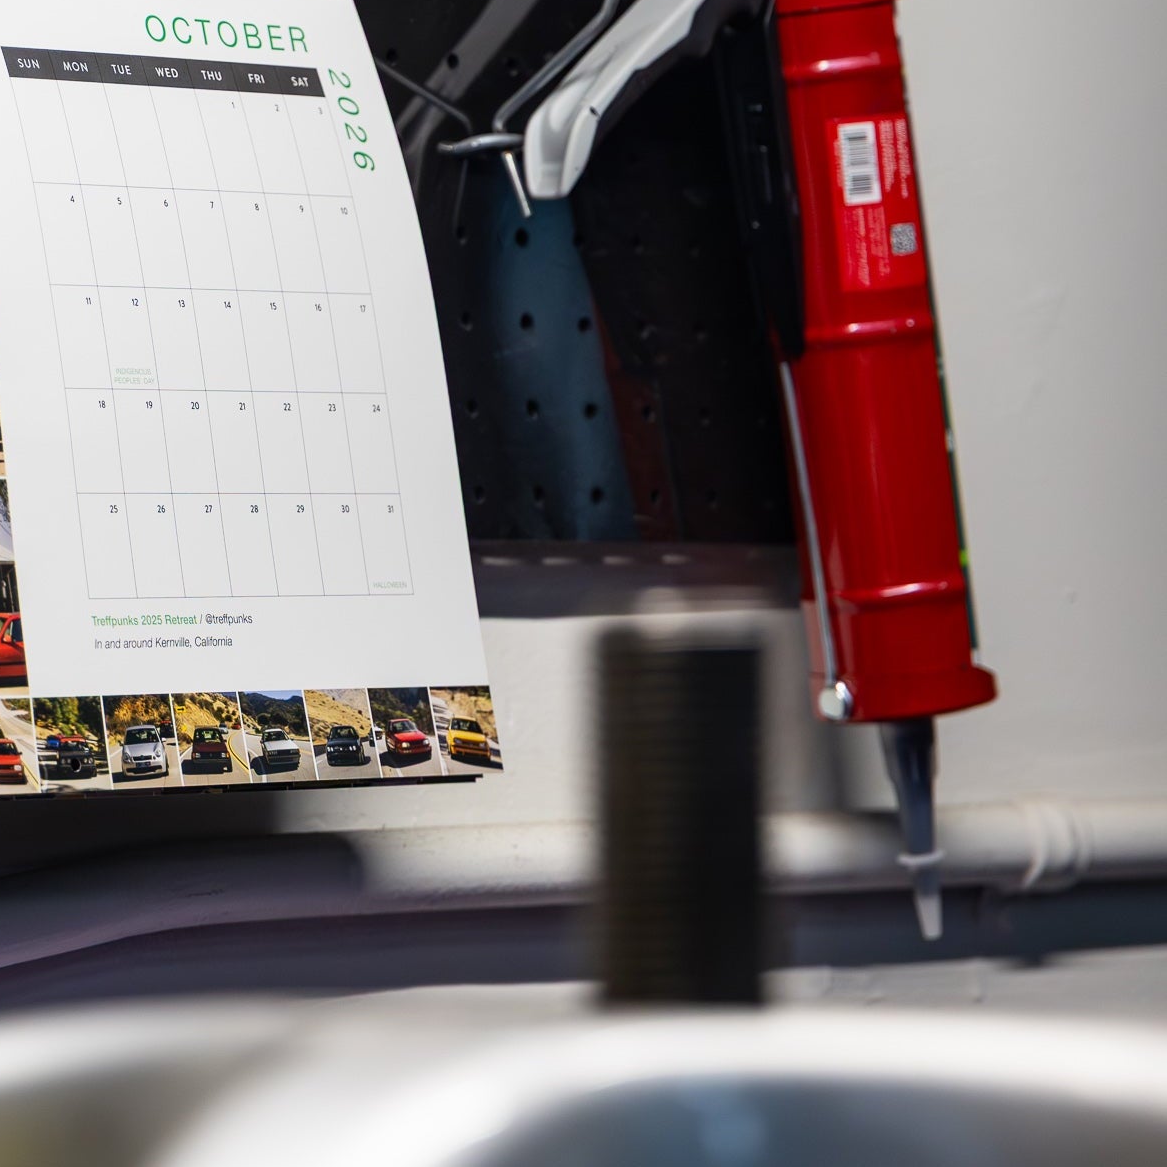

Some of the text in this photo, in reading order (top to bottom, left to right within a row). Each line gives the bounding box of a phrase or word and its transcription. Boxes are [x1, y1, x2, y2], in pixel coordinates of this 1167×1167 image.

[144, 14, 308, 53] OCTOBER
[17, 57, 309, 87] SUN MON TUE WED THU FRI SAT
[327, 67, 376, 172] 2026
[340, 206, 349, 216] 10
[85, 296, 367, 313] 11 12 13 14 15 16 17
[98, 400, 381, 413] 18 19 20 21 22 23 24
[109, 504, 395, 514] 25 26 27 28 29 30 31
[91, 614, 139, 629] Treffpunks
[140, 614, 163, 626] 2025
[165, 614, 198, 626] Retreat
[205, 613, 253, 627] @treffpunks
[94, 635, 233, 650] In and around Kernville, California
